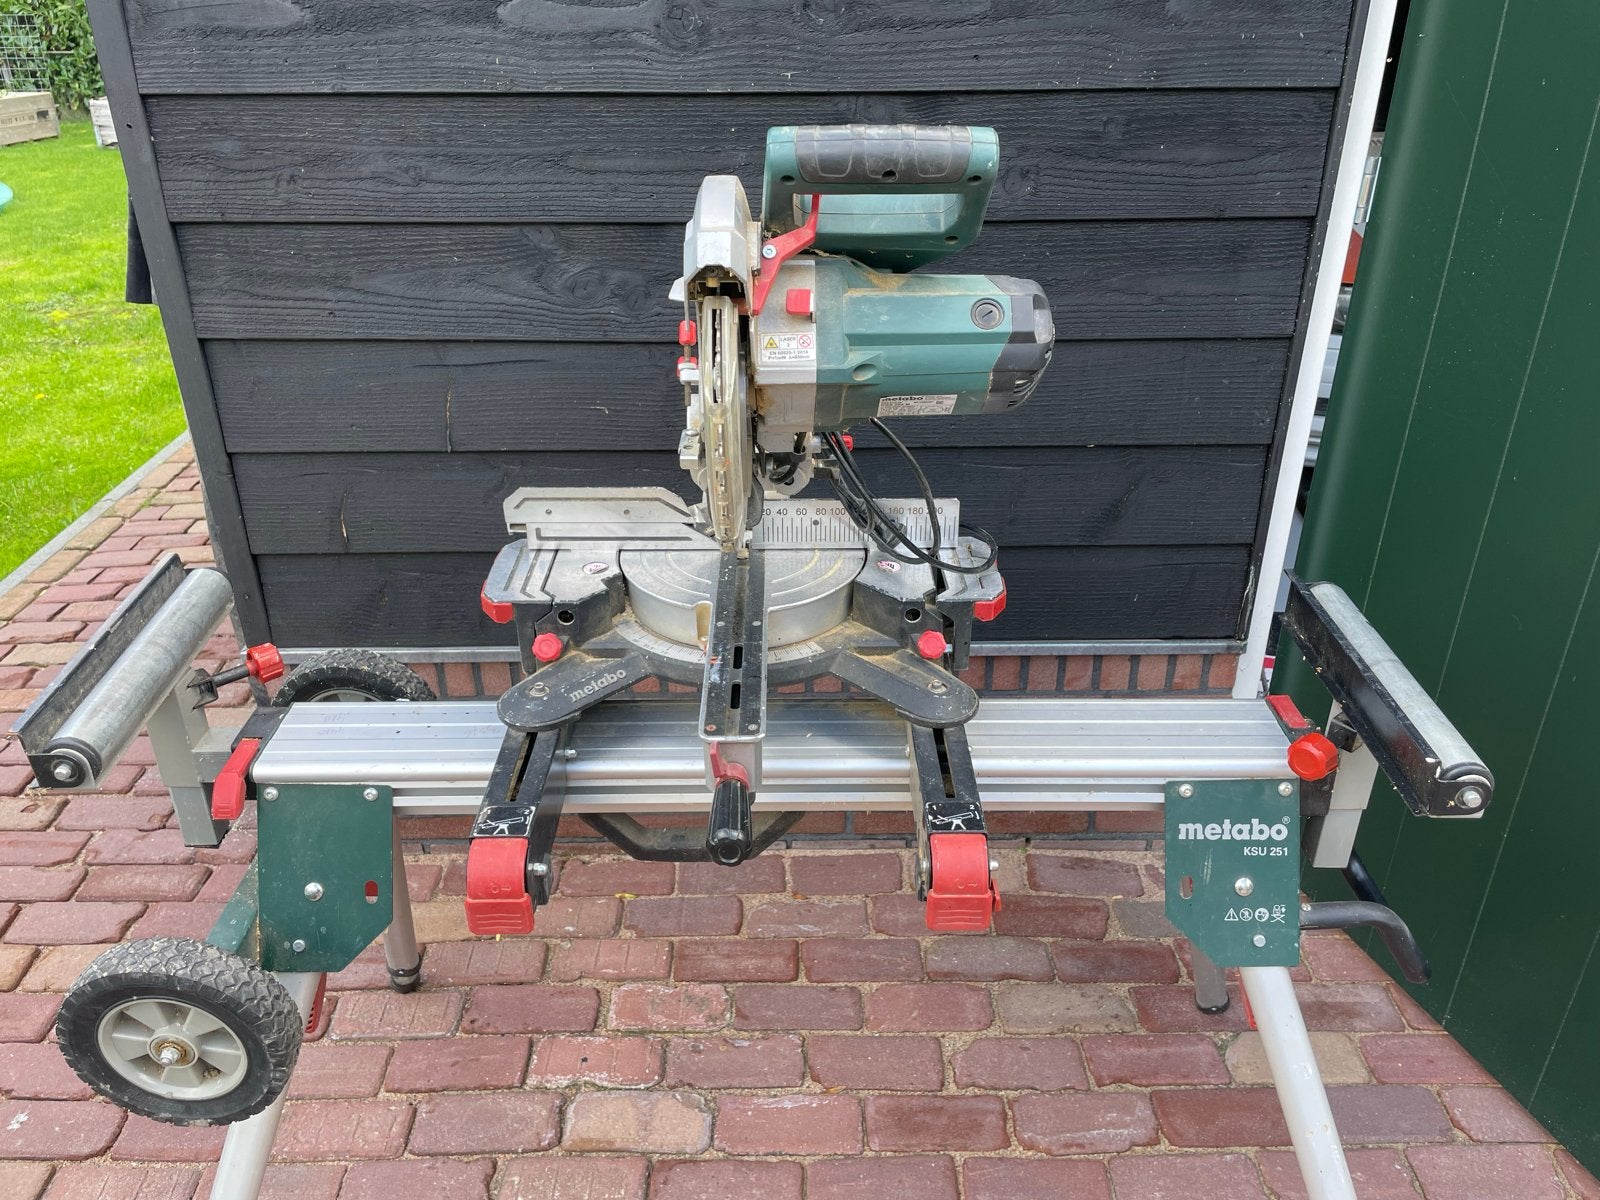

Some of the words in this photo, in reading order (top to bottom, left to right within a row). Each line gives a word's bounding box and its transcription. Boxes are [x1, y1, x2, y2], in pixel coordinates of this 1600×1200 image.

[776, 508, 788, 516] 40
[796, 508, 807, 516] 60
[815, 508, 827, 516] 80
[830, 507, 846, 516] 100
[888, 506, 905, 515] 160
[908, 507, 924, 515] 180
[569, 669, 627, 703] metabo
[1243, 847, 1267, 856] KSU
[1270, 847, 1288, 856] 251
